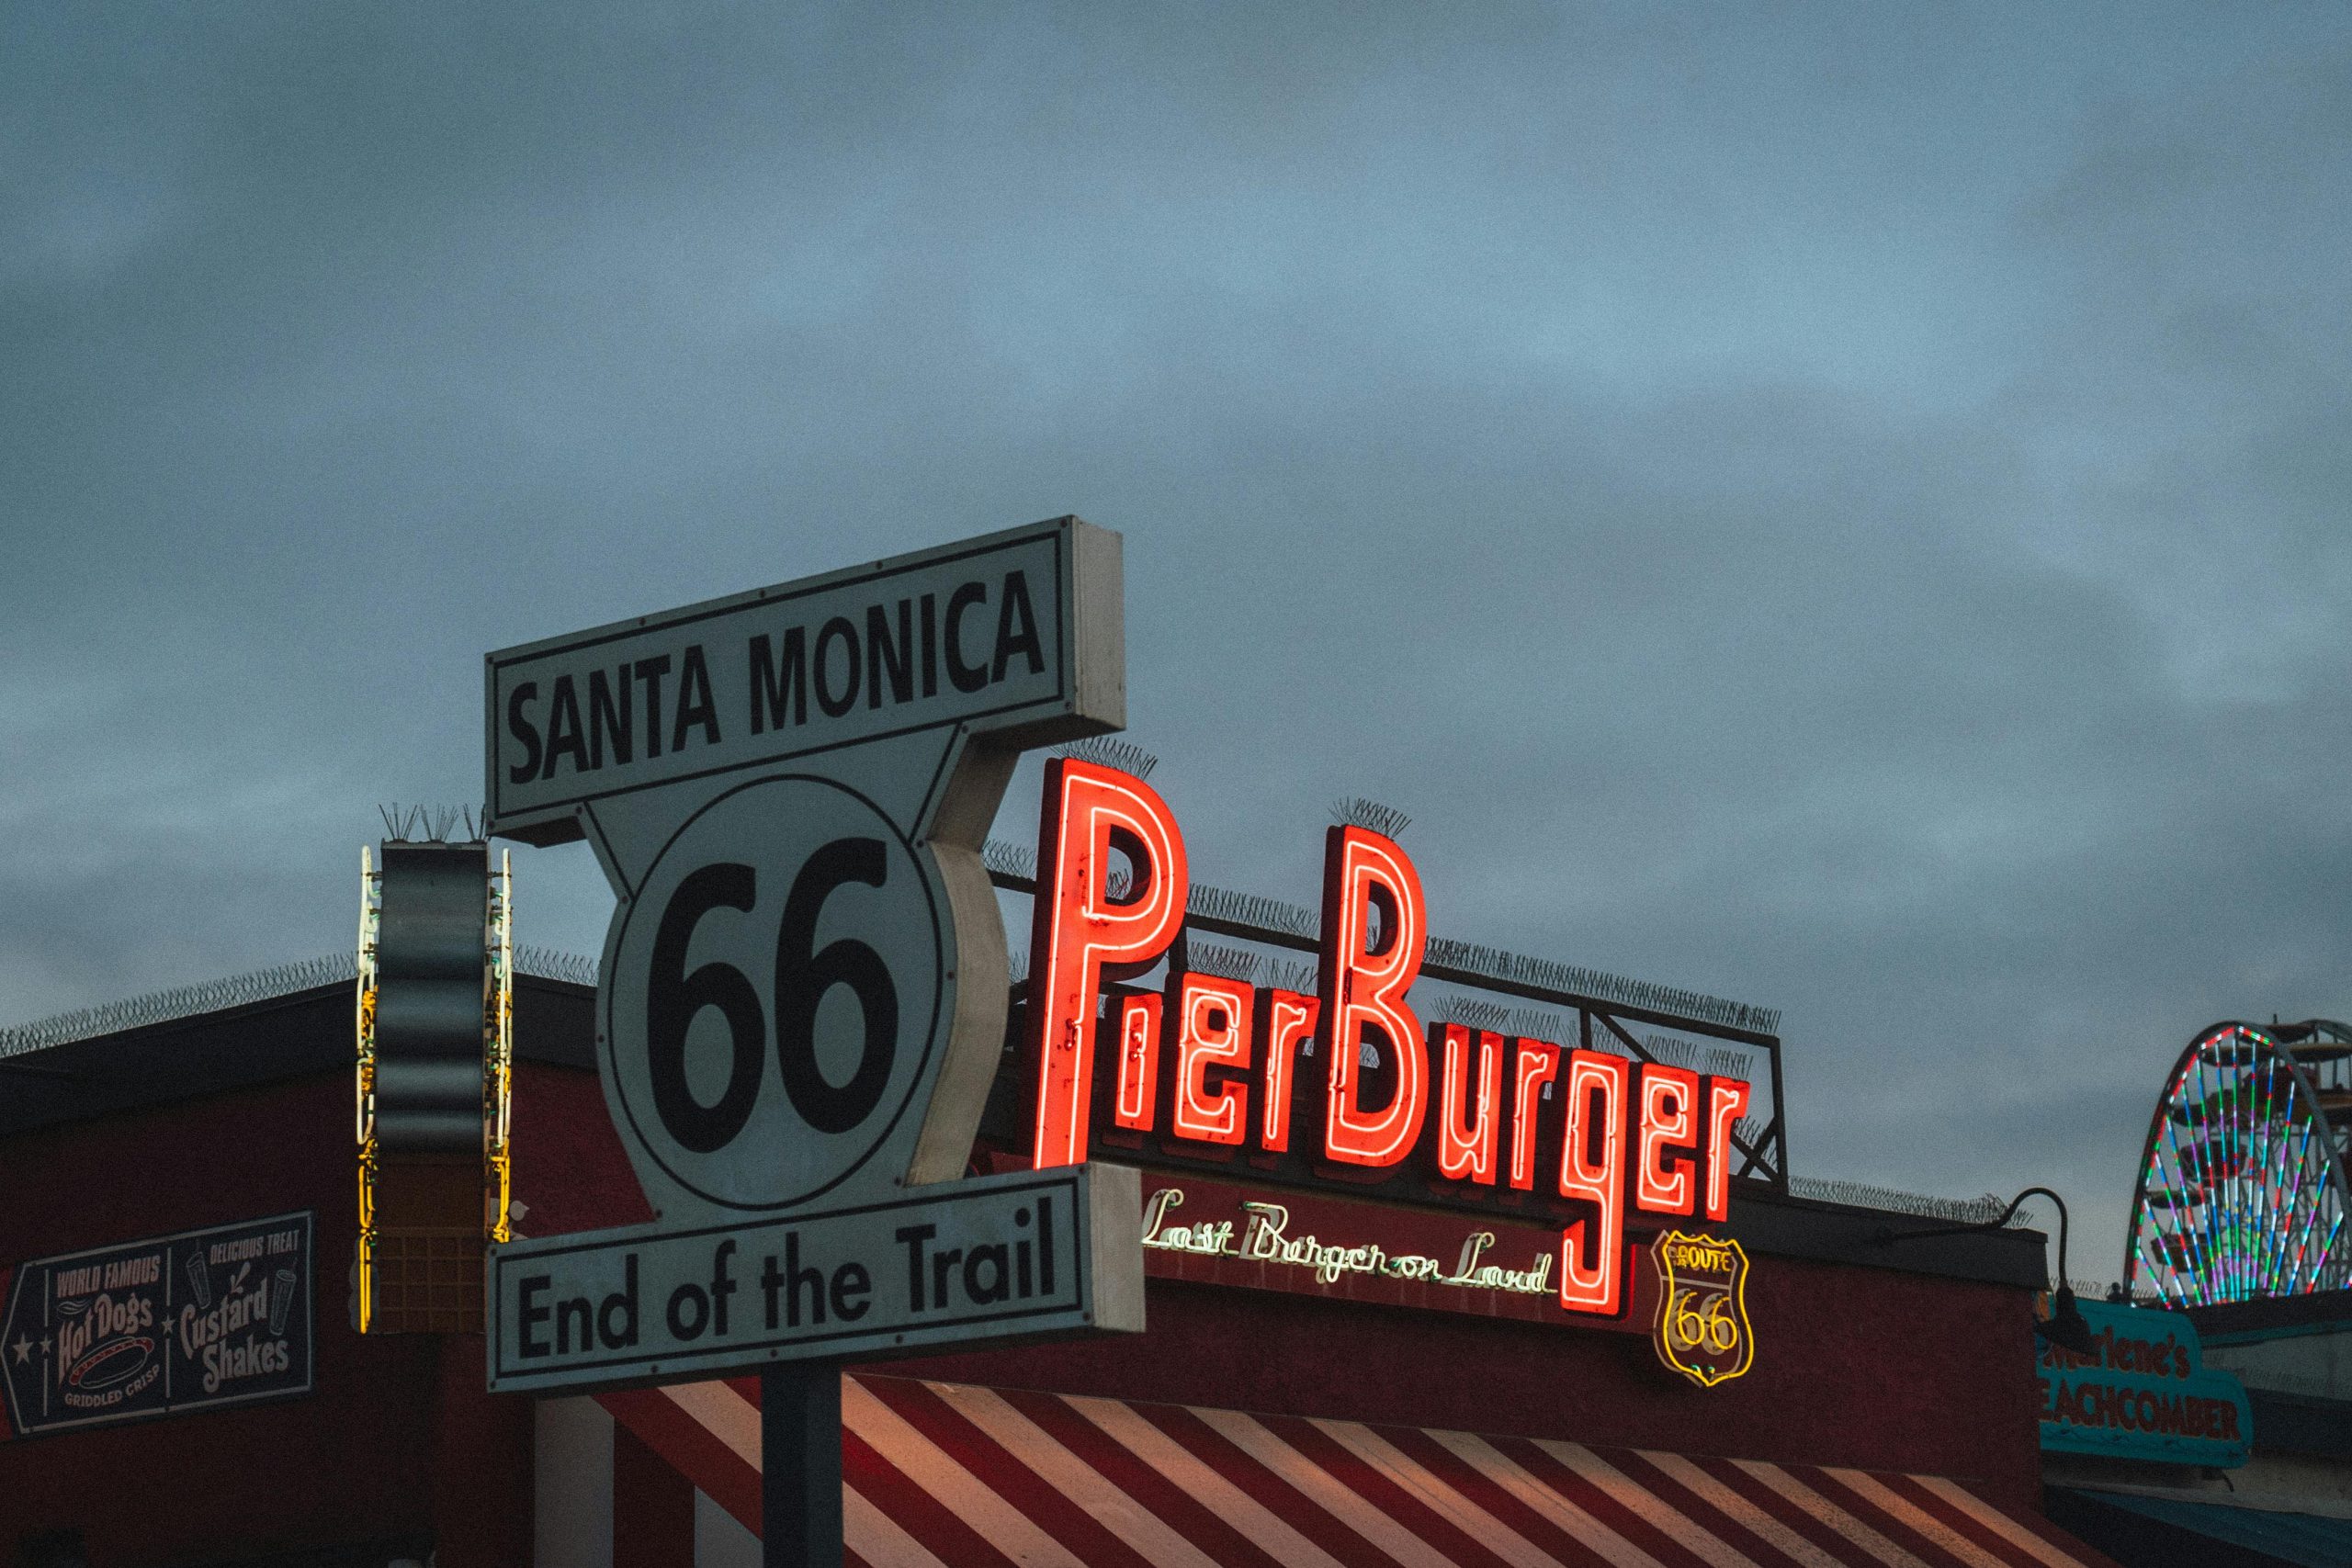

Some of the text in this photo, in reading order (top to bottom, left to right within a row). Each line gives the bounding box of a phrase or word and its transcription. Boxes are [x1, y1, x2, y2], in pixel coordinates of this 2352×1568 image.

[507, 570, 1046, 784] SANTA MONICA
[648, 837, 899, 1154] 66
[57, 1255, 161, 1299] WORLD FAMOUS
[210, 1229, 300, 1265] DELICIOUS TREAT
[1141, 1189, 1558, 1293] Last Burger on Land
[1675, 1245, 1733, 1272] ROUTE
[517, 1197, 1057, 1359] End of the Trail
[58, 1292, 153, 1389] Hot Dogs
[180, 1277, 268, 1359] Custard
[1672, 1290, 1738, 1352] 66
[64, 1364, 160, 1407] GRIDDLED CRISP
[202, 1334, 289, 1393] Shakes
